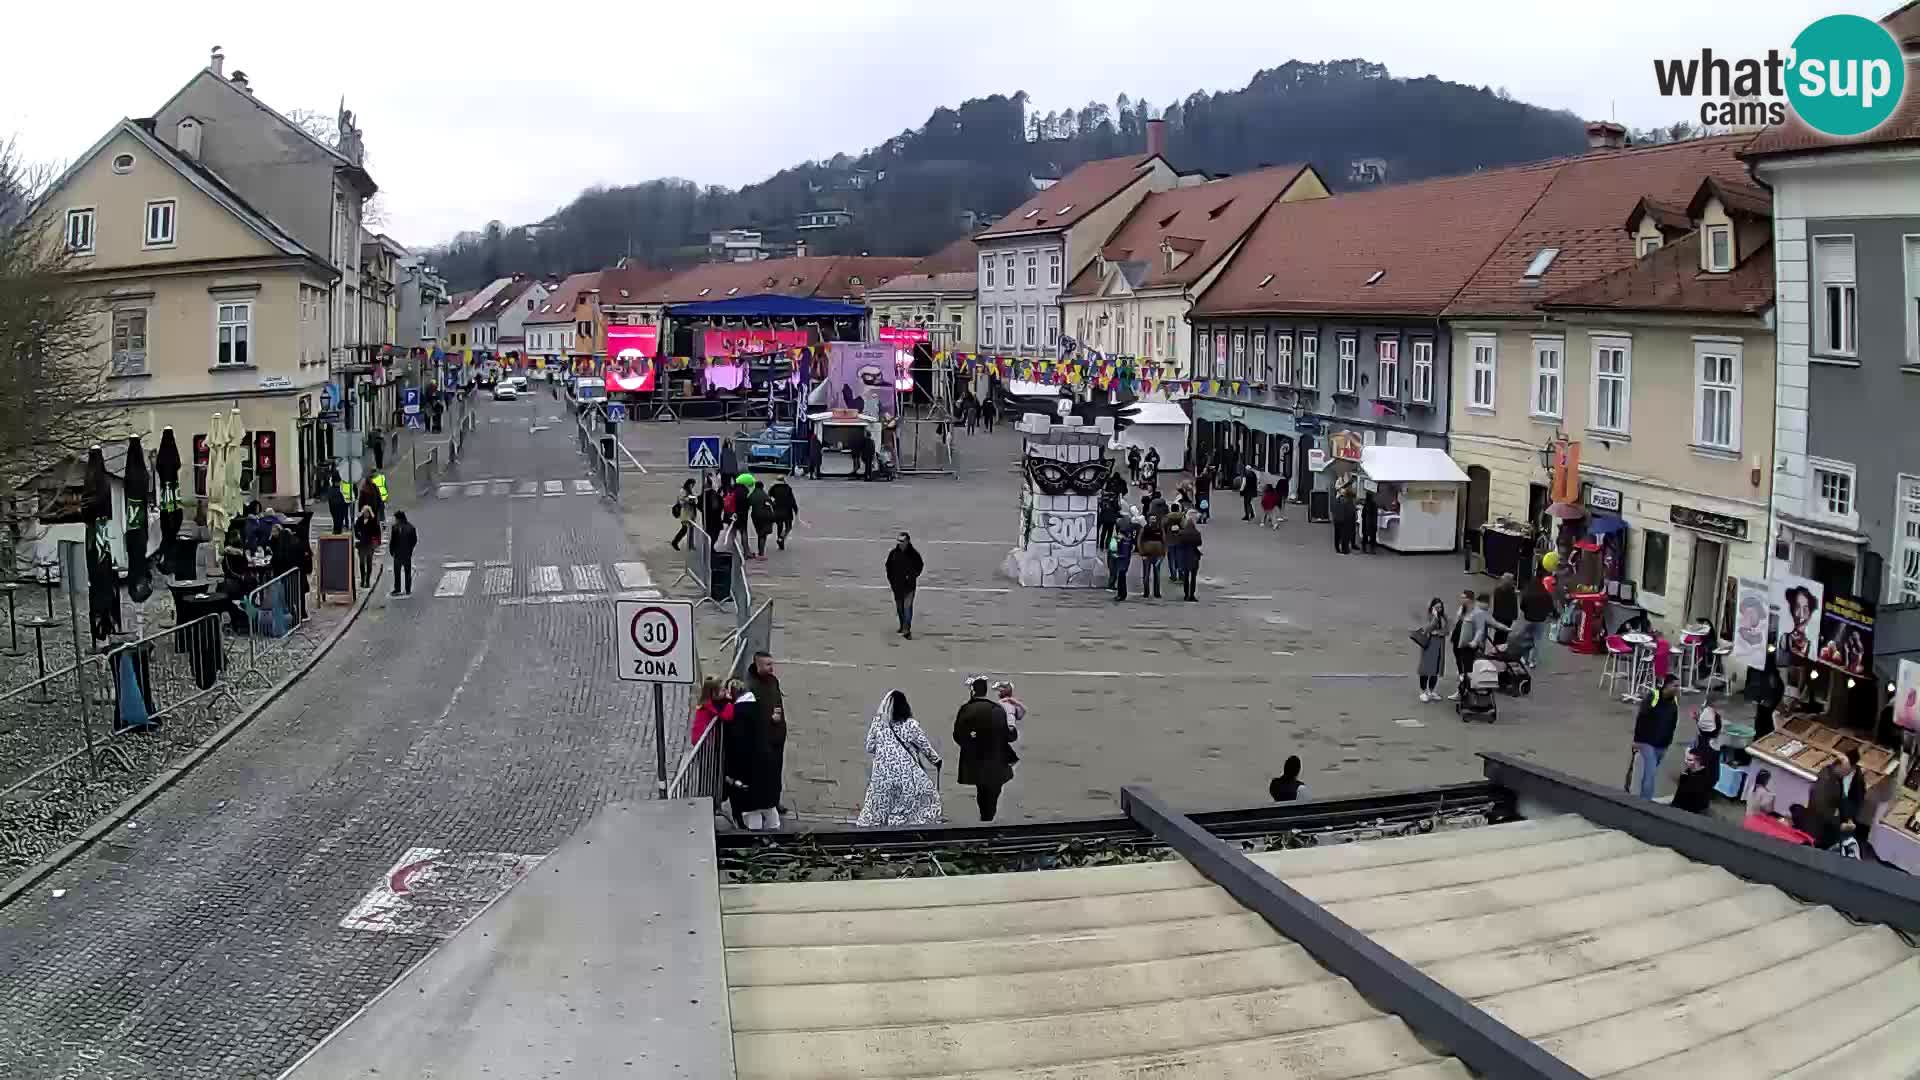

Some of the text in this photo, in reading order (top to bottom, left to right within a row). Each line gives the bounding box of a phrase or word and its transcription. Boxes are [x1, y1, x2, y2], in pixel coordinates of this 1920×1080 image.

[407, 391, 416, 403] P
[1048, 516, 1087, 545] 200
[643, 622, 667, 644] 30
[633, 659, 679, 677] ZONA
